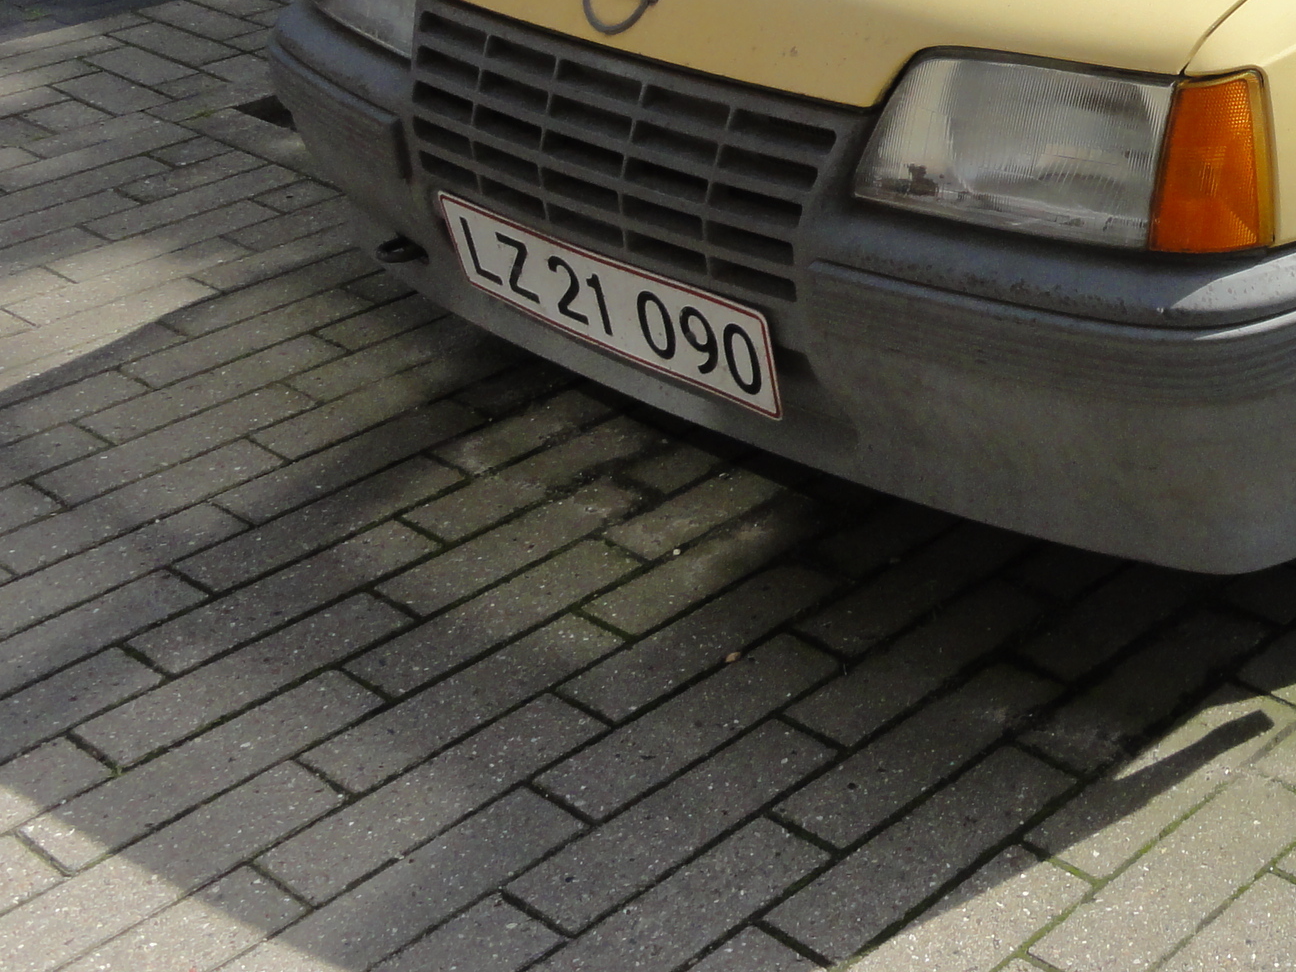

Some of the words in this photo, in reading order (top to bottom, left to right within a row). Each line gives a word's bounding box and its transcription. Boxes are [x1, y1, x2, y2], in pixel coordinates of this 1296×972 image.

[459, 216, 541, 304] LZ
[547, 255, 614, 337] 21
[636, 290, 763, 396] 090
